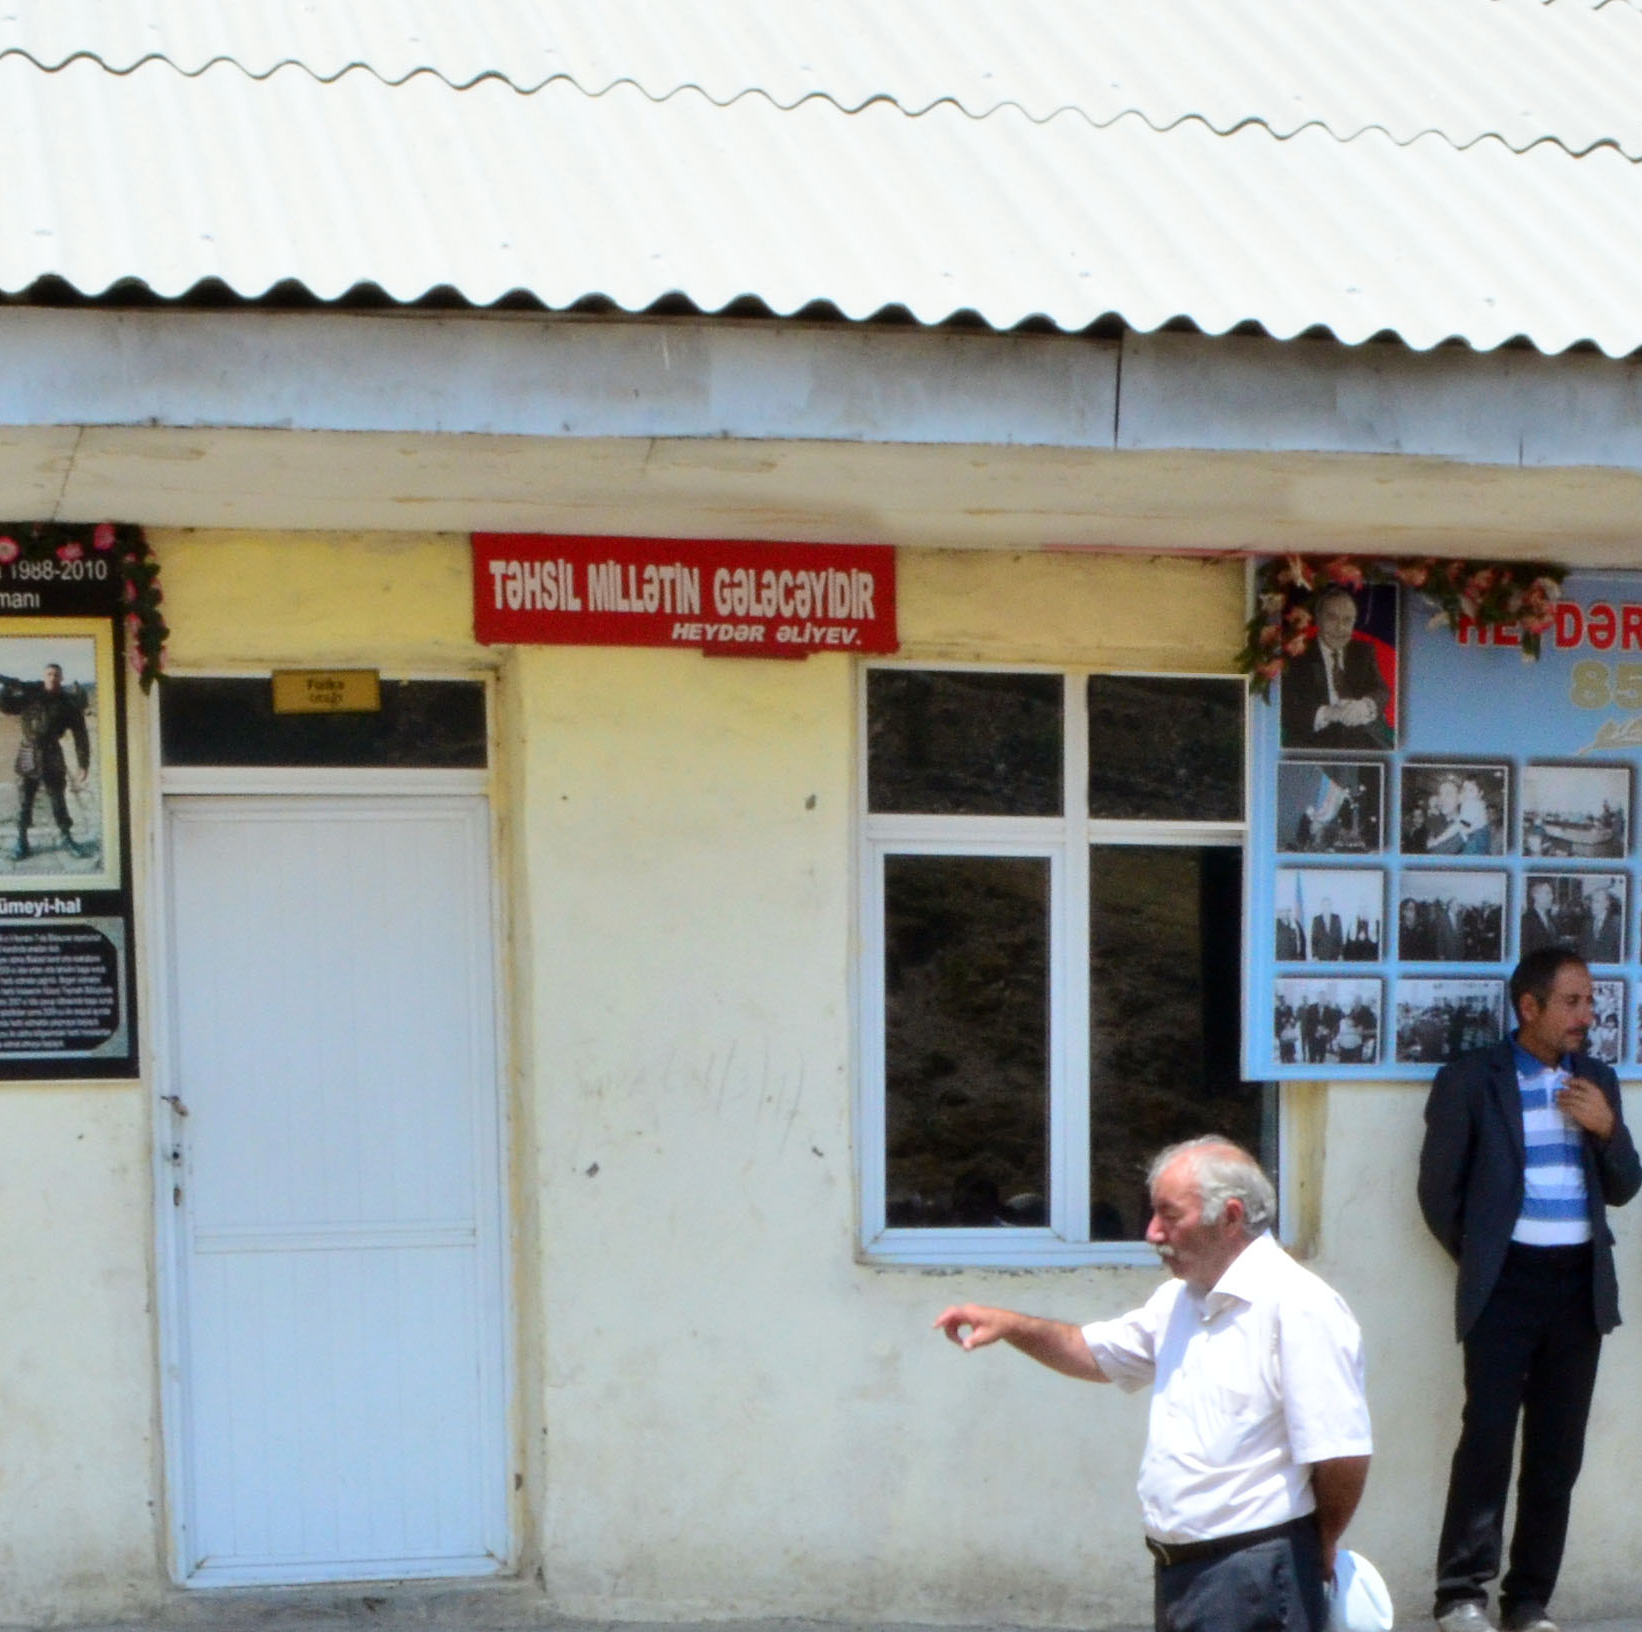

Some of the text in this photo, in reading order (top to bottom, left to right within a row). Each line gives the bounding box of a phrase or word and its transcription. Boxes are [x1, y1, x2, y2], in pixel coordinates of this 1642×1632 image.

[11, 559, 107, 580] 1988-2010
[489, 558, 876, 620] TƏHSİL MİLLƏTİN GƏLƏCƏYİDİR
[672, 623, 765, 643] HEYDƏR
